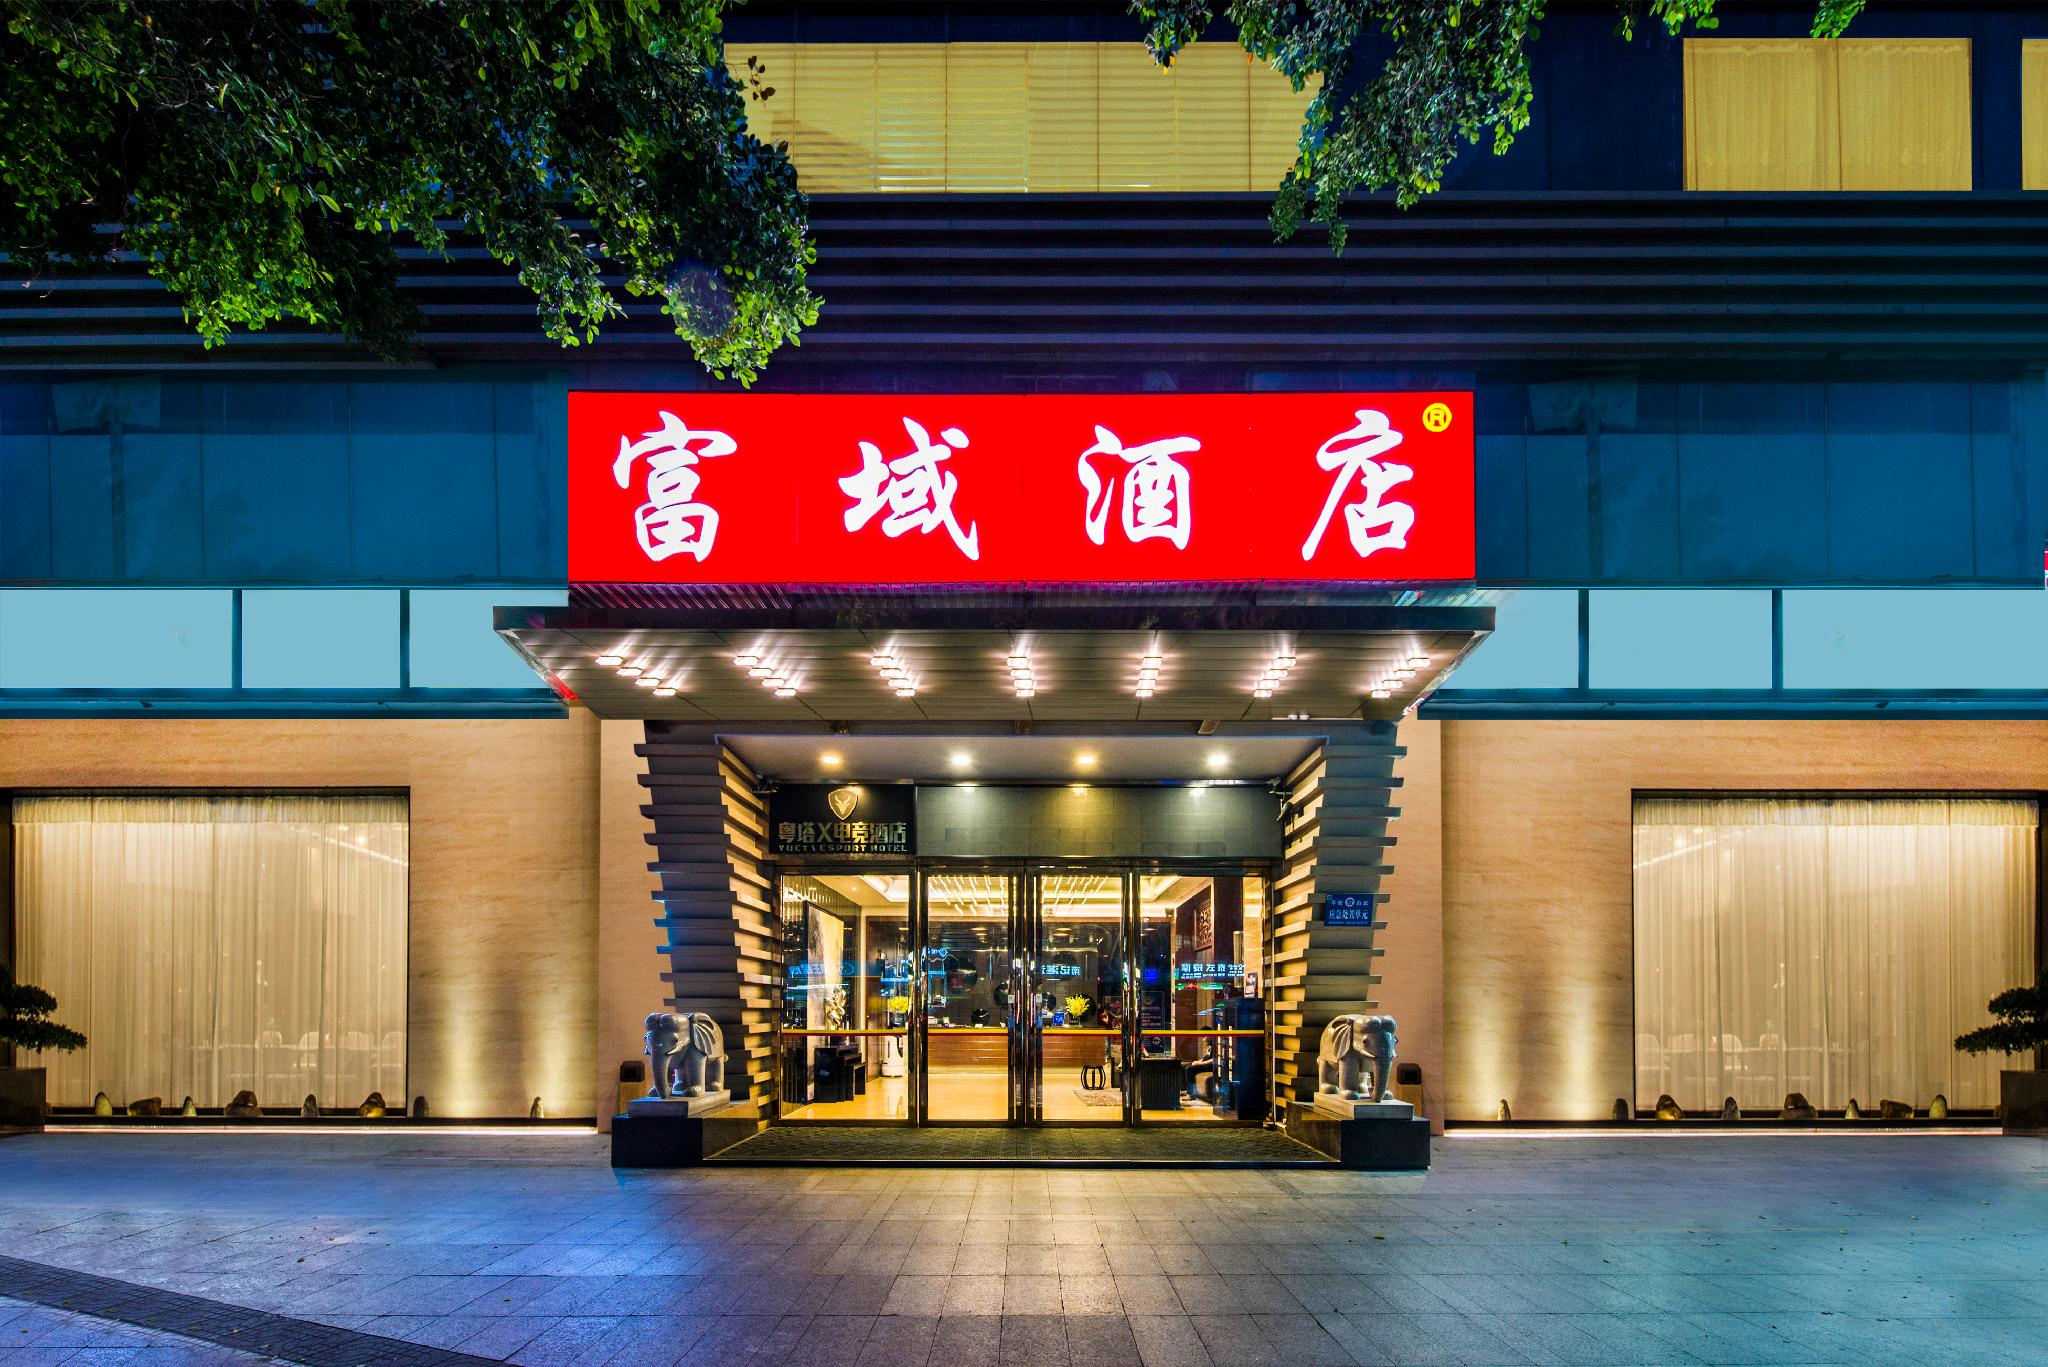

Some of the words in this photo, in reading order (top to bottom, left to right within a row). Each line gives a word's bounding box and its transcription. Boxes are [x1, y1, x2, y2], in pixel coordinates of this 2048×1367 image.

[613, 410, 1414, 562] 富域酒店
[778, 822, 907, 844] 粤塔X电竞酒店
[819, 844, 867, 852] ESPORT
[870, 844, 908, 852] HOTEL
